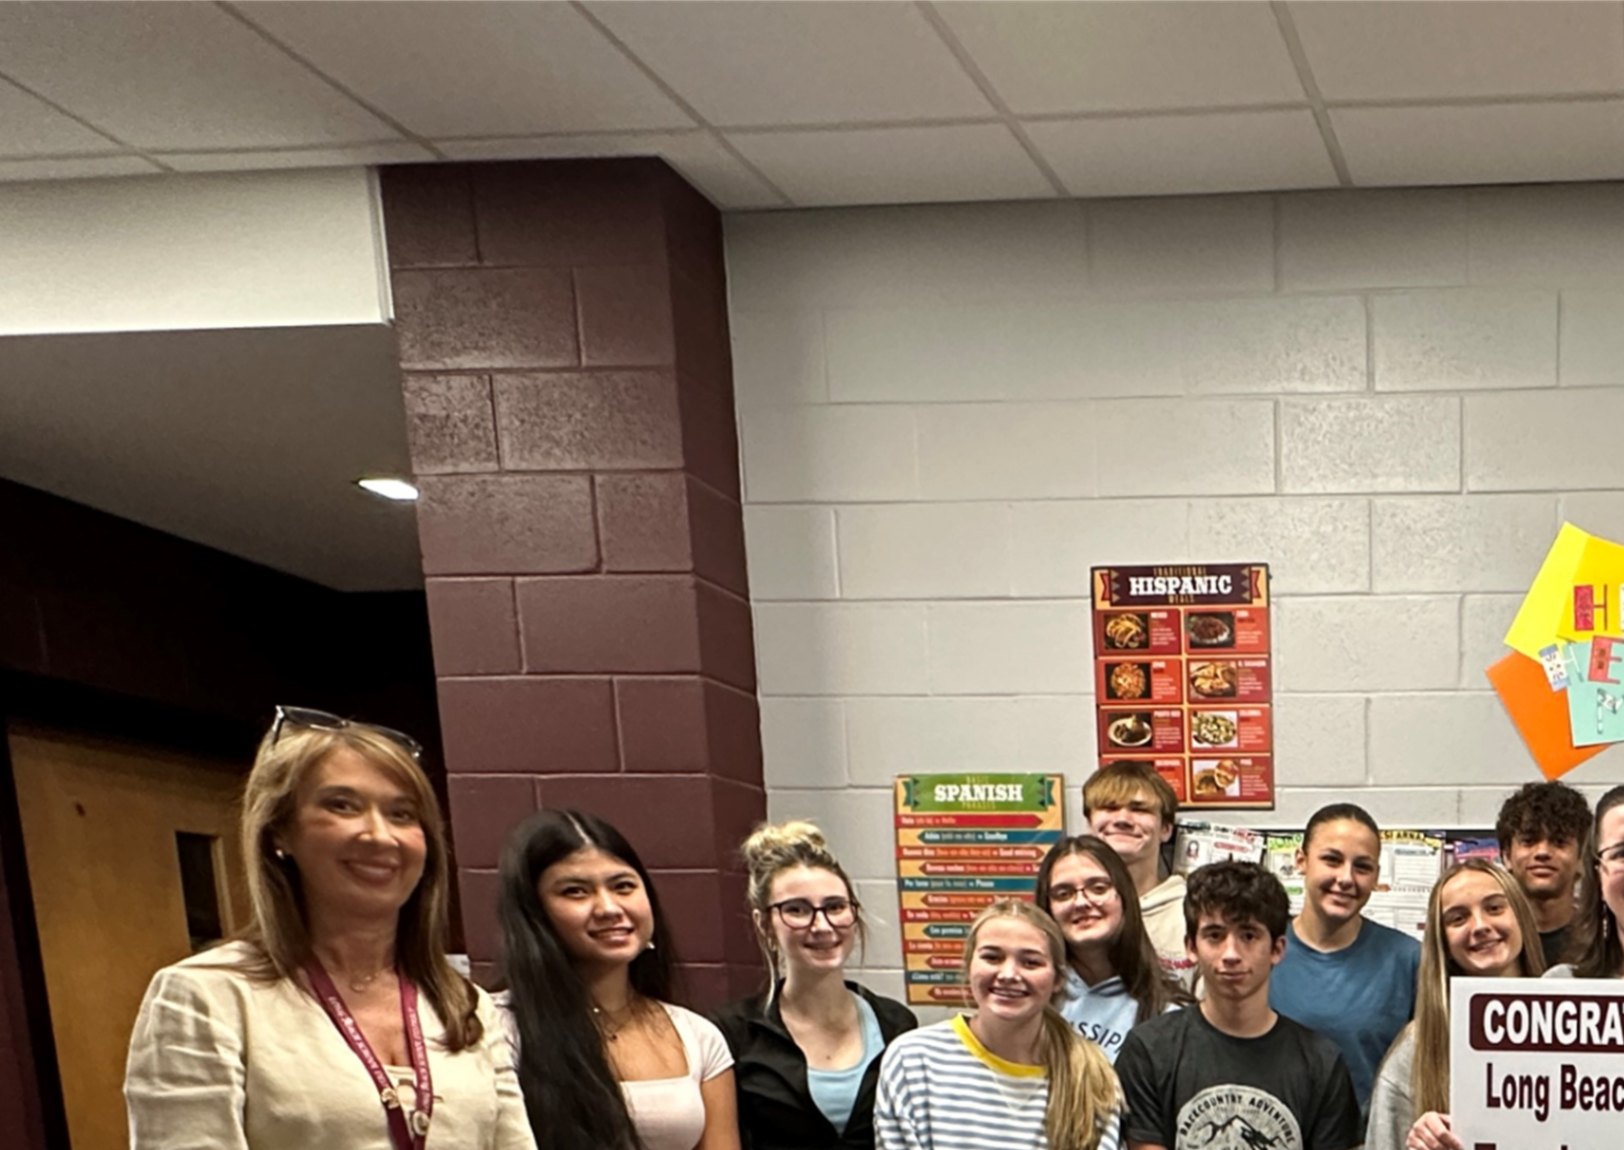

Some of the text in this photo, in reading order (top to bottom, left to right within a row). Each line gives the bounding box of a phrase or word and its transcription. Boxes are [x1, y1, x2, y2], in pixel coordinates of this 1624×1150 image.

[1129, 575, 1232, 596] HISPANIC
[934, 784, 1024, 801] SPANISH
[1486, 1062, 1550, 1122] Long
